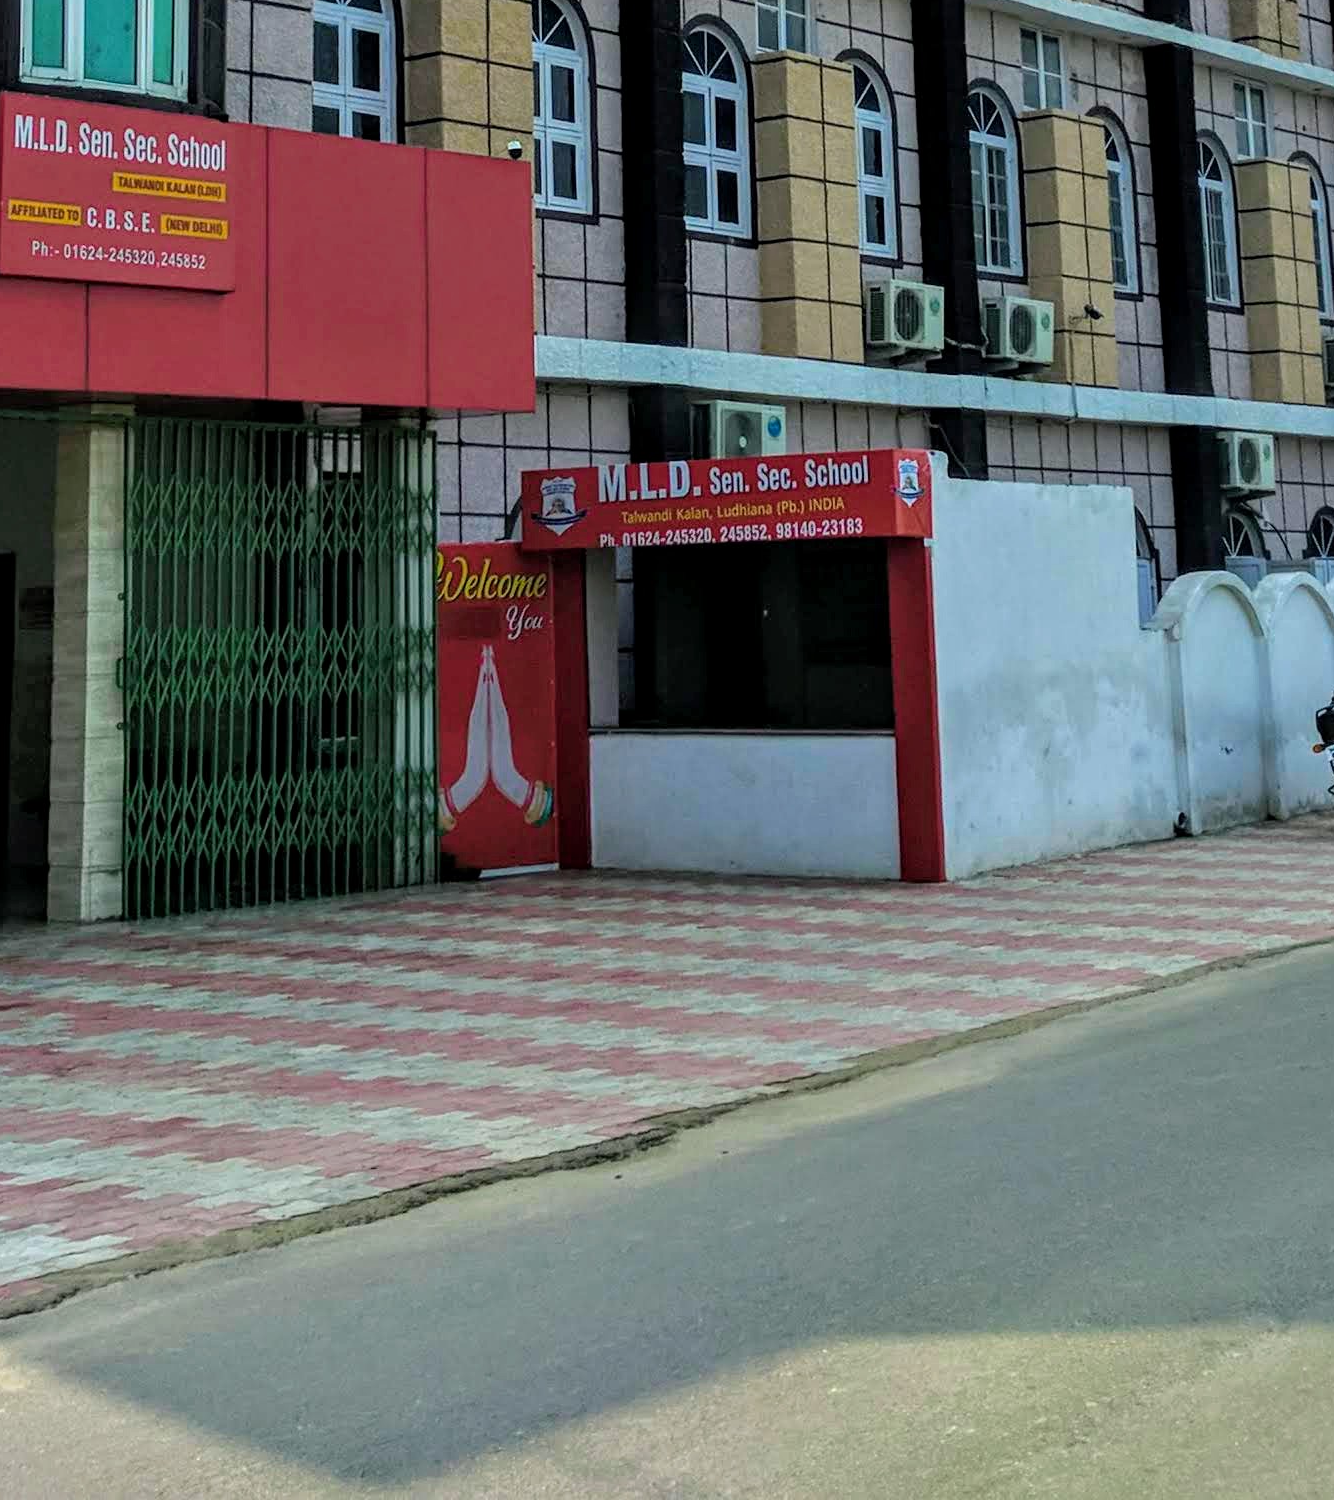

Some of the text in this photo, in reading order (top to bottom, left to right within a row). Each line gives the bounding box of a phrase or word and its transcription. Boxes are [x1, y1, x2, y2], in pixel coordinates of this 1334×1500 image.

[14, 114, 226, 171] M.L.D. Sen. Sec. School
[119, 176, 221, 199] TALWANDI KALAN (LDH)
[11, 204, 65, 219] AFFILIATED
[67, 209, 79, 222] TO
[166, 218, 190, 231] (NEW
[192, 220, 223, 235] DELHI)
[597, 460, 702, 502] M.L.D.
[709, 466, 750, 495] Sen.
[757, 462, 797, 491] Sec.
[804, 455, 869, 488] School
[620, 496, 845, 524] Talwandi Kalan, Ludhiana (Pb.) INDIA
[599, 533, 619, 548] Ph.
[775, 517, 864, 539] 98140-23183
[437, 552, 548, 601] Welcome
[506, 604, 544, 640] You
